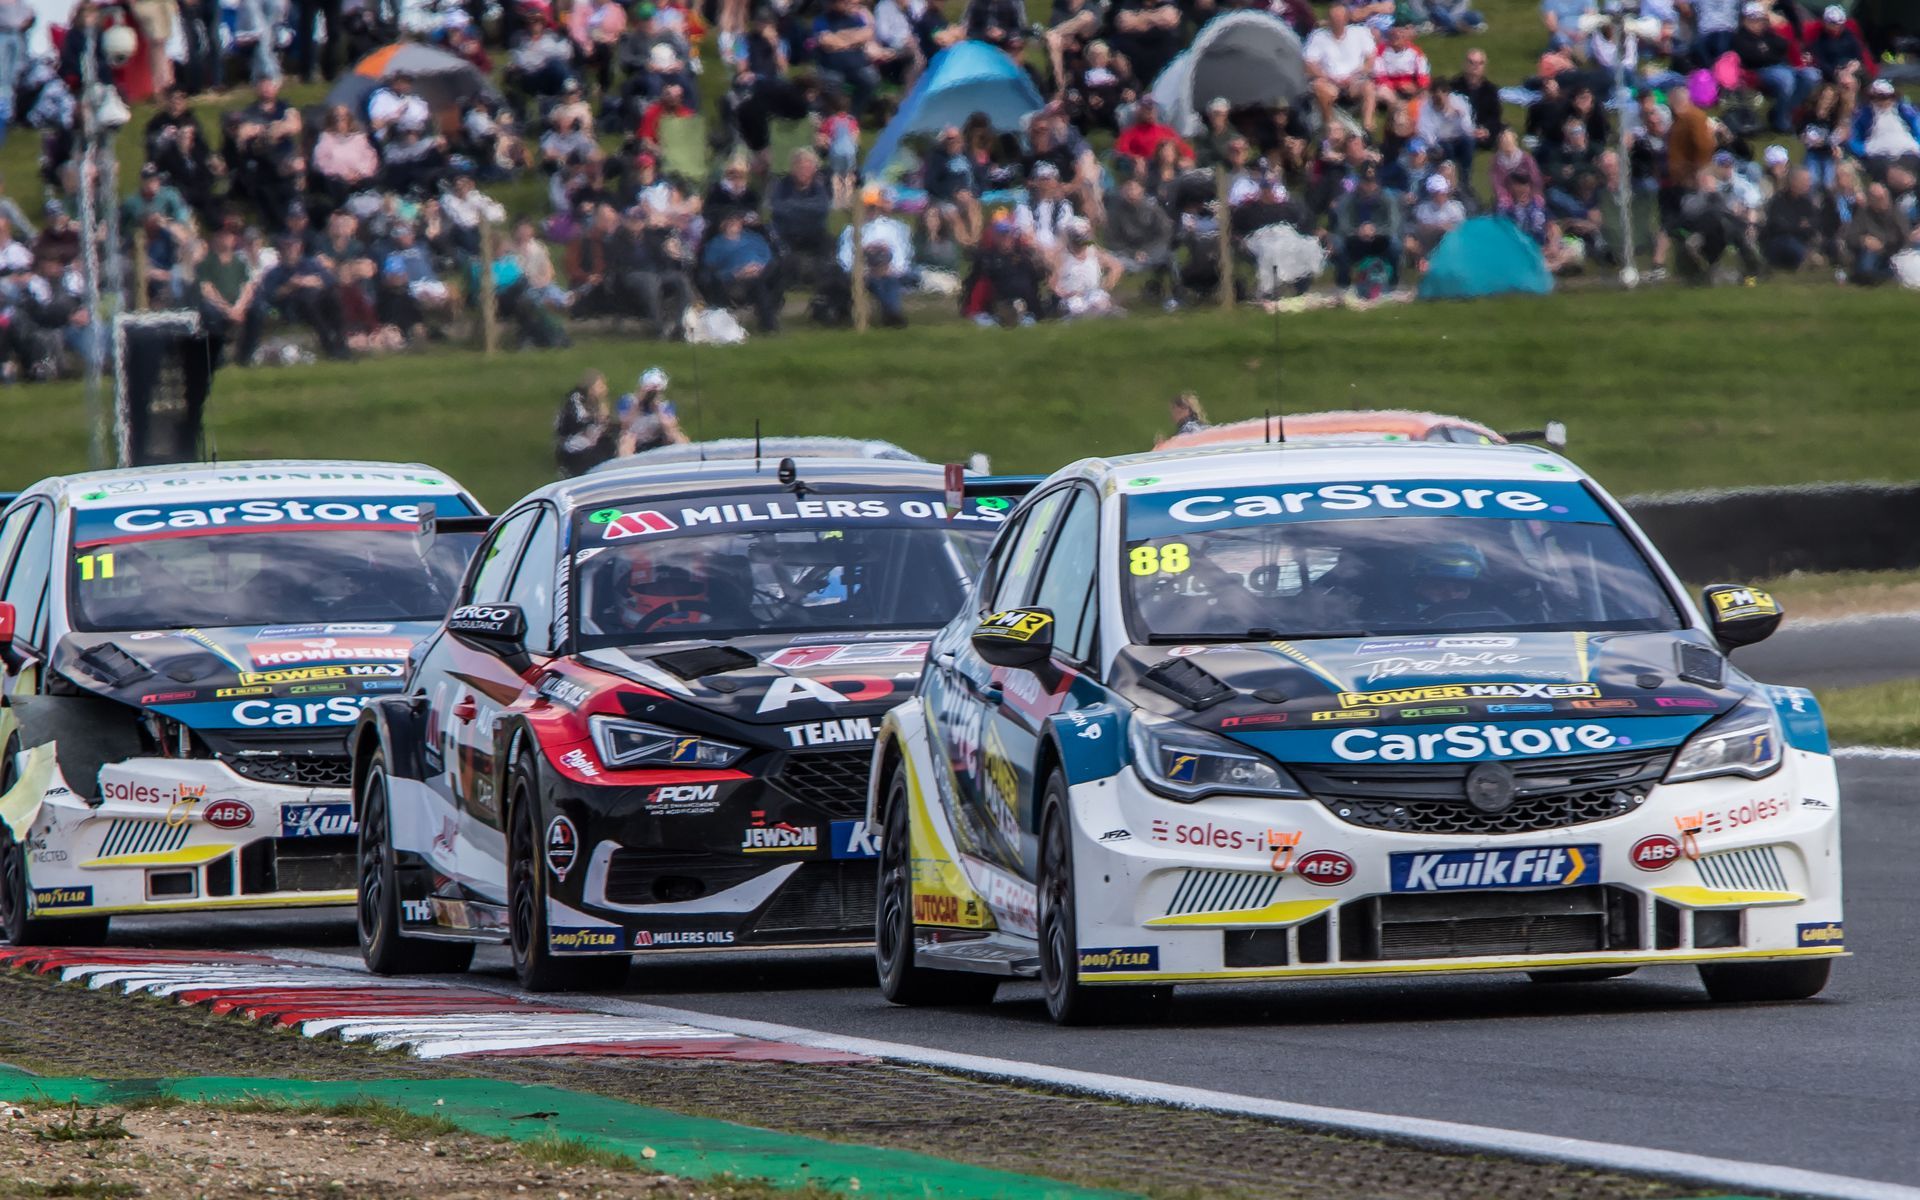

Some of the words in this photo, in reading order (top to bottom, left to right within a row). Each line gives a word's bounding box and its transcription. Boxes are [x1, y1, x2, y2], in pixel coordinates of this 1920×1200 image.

[113, 500, 419, 532] CarStore
[680, 501, 890, 527] MILLERS
[76, 552, 115, 580] 11
[1129, 543, 1191, 576] 88
[452, 606, 511, 621] ERGO
[258, 647, 411, 665] HOWDENS
[246, 666, 346, 683] POWER
[1346, 685, 1466, 705] POWER
[1471, 683, 1593, 699] MAXED
[104, 781, 178, 805] sales-i
[210, 807, 248, 821] ABS
[741, 826, 818, 848] JEWSON
[1176, 822, 1263, 851] sales-i
[1638, 845, 1677, 862] ABS
[1302, 860, 1348, 877] ABS
[653, 932, 705, 944] MILLERS
[706, 931, 735, 943] OILS
